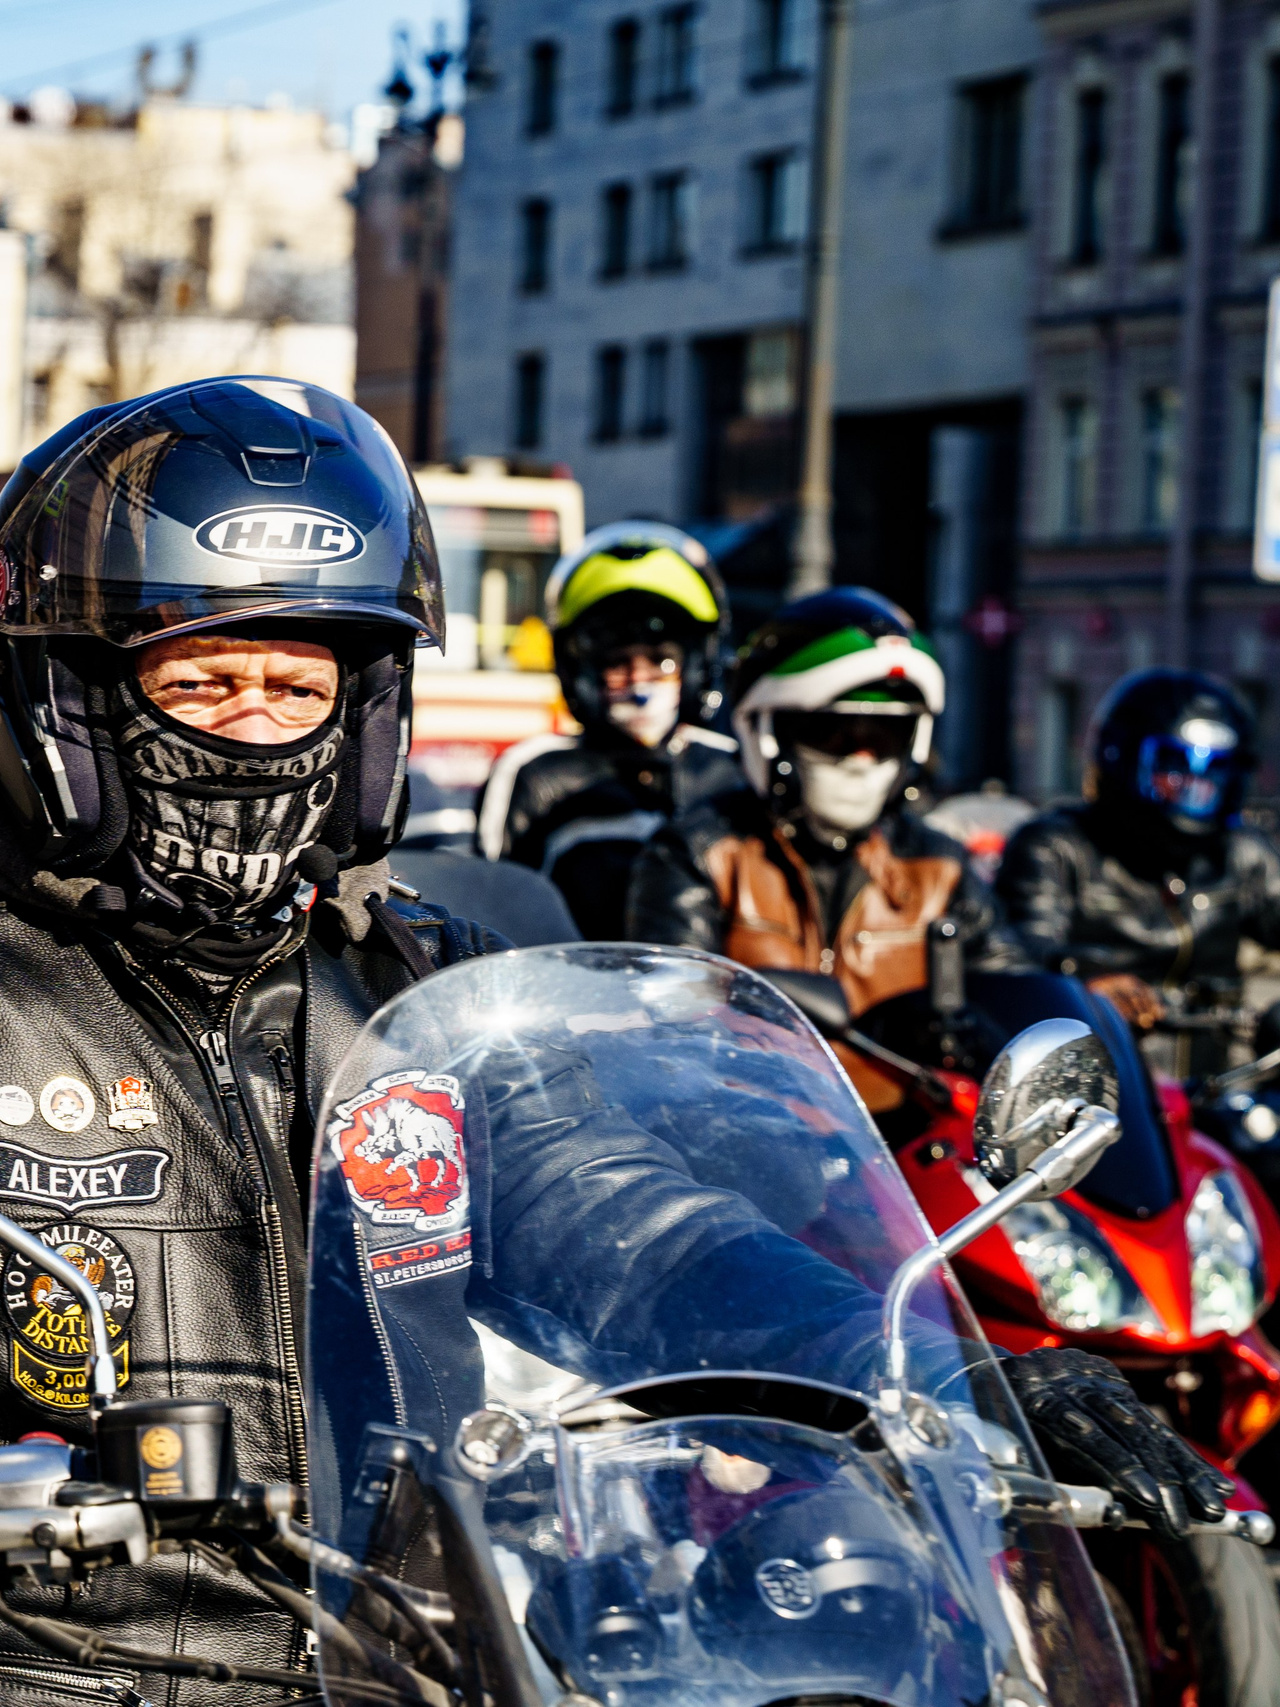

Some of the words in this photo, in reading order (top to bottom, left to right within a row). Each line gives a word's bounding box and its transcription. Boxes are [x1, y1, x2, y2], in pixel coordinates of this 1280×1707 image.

[221, 521, 345, 553] HJC
[7, 1158, 128, 1198] ALEXEY
[370, 1243, 440, 1270] RED
[44, 1370, 88, 1390] 3,00
